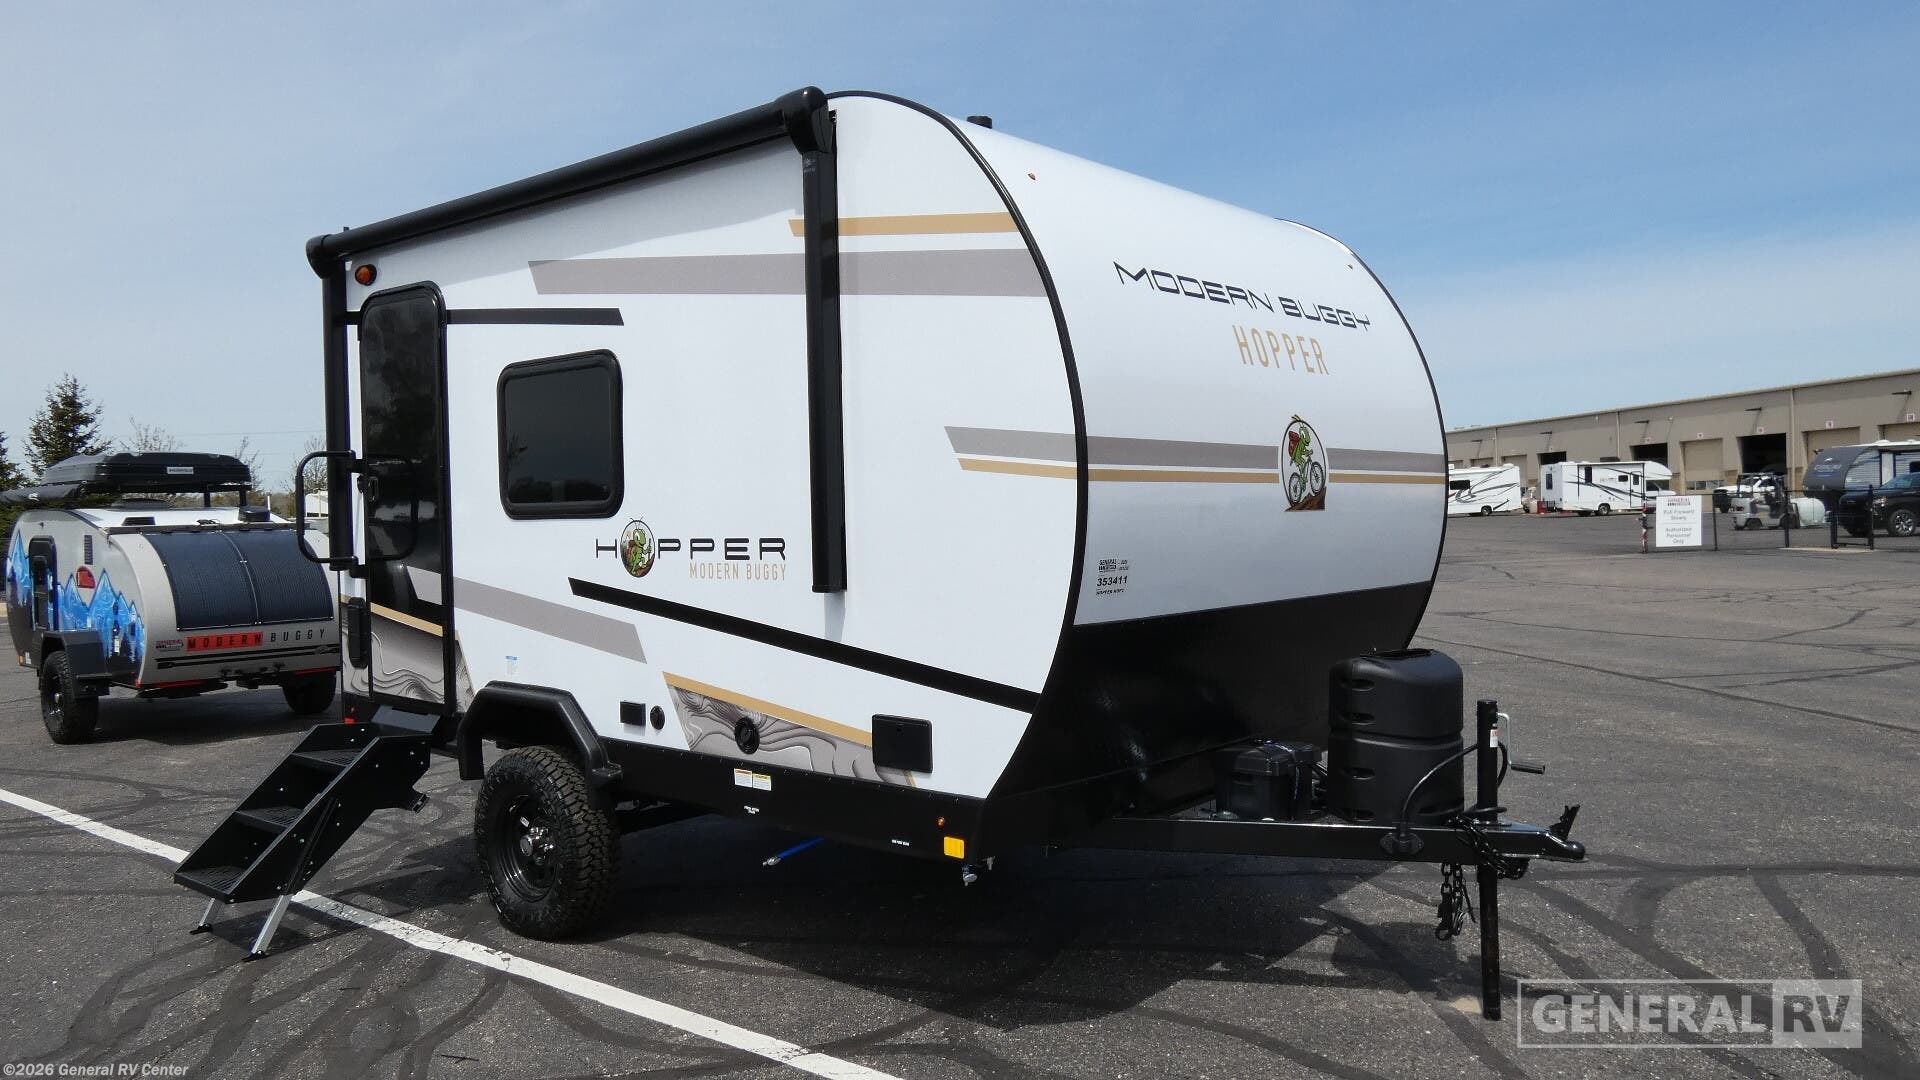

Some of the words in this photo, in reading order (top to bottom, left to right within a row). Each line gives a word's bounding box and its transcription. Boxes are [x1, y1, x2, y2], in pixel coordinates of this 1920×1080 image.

[1113, 261, 1275, 313] MODERN
[1278, 296, 1371, 331] BUGGY
[1232, 324, 1330, 376] HOPPER
[689, 562, 739, 580] MODERN
[746, 563, 787, 581] BUGGY
[1096, 575, 1128, 587] 353411
[187, 634, 262, 649] MODERN
[270, 629, 326, 642] BUGGY
